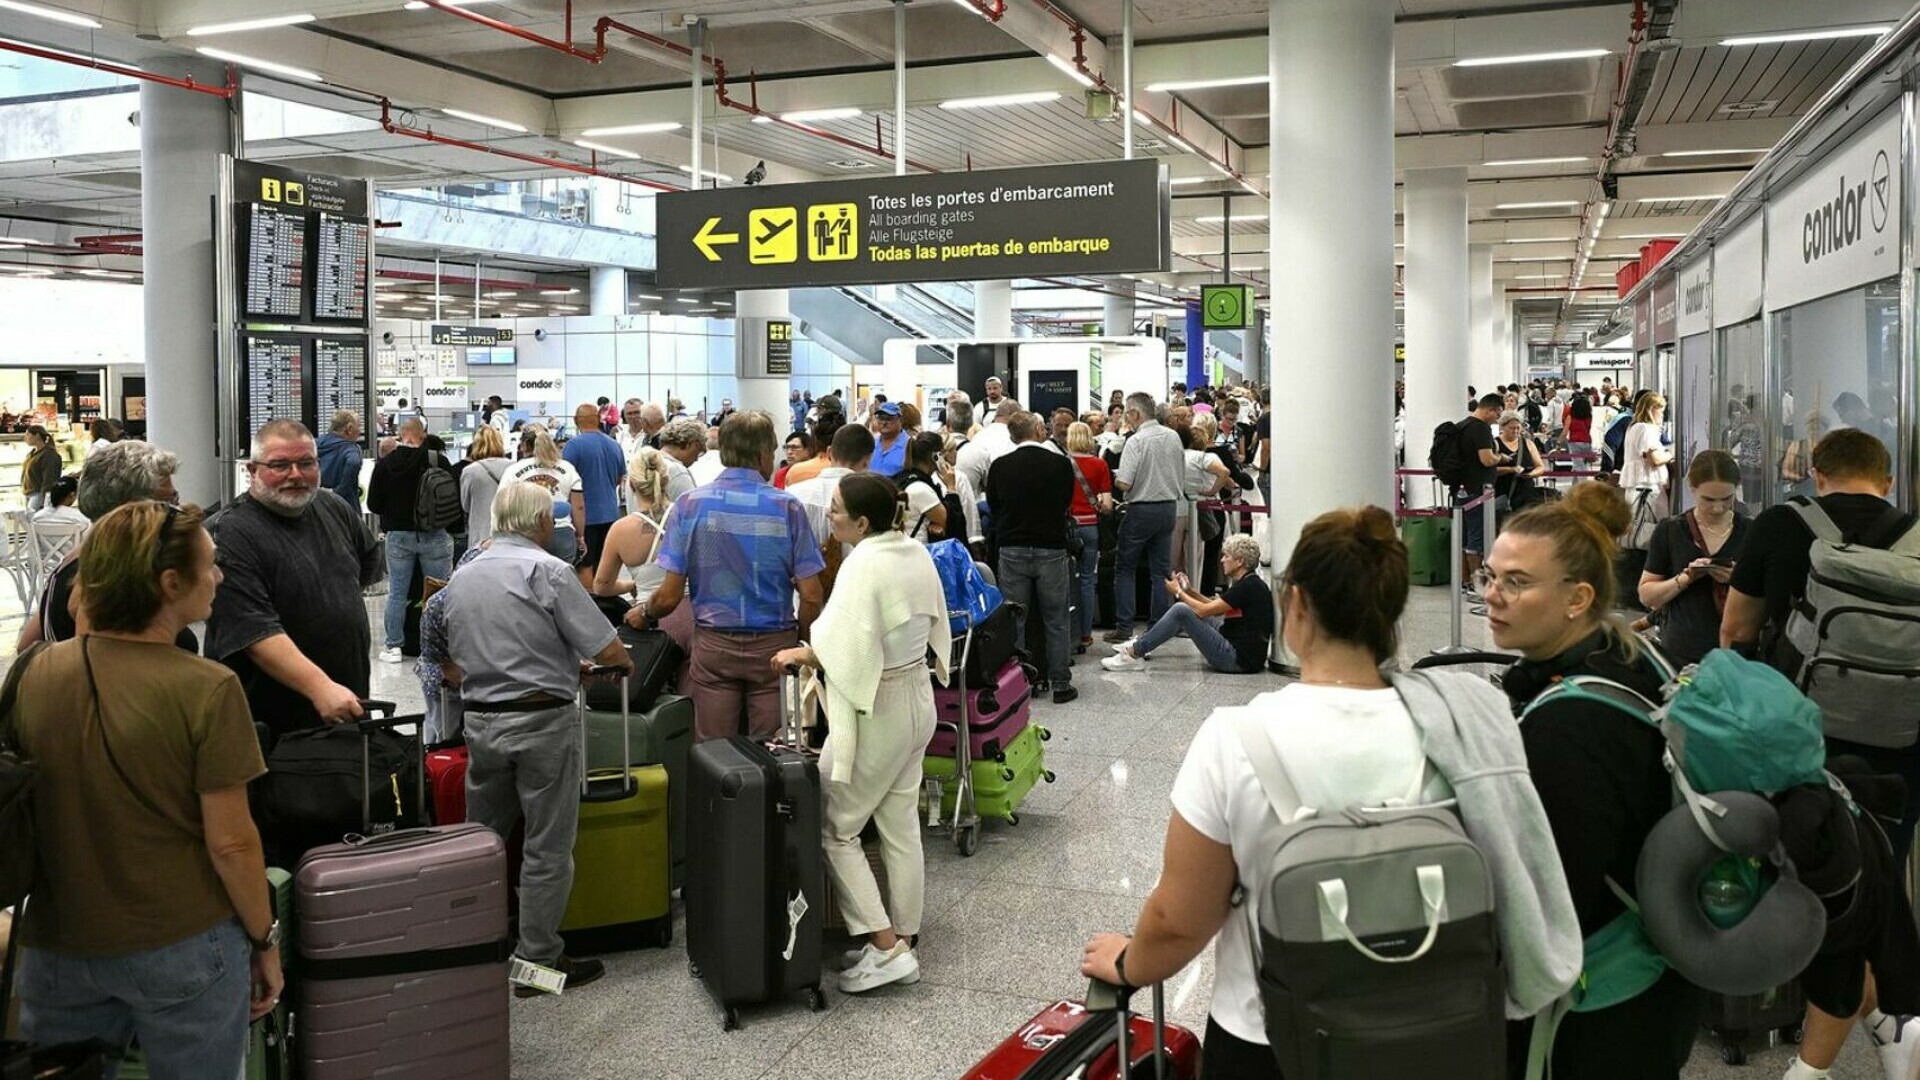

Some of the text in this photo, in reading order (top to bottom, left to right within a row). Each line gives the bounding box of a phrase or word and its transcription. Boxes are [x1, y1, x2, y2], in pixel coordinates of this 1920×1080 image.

[868, 182, 1114, 210] Totes les portes d'embarcament
[868, 210, 975, 227] All boarding gates
[1803, 175, 1866, 264] condor
[868, 227, 954, 244] Alle Flugsteige
[868, 237, 1110, 262] Todas las puertas de embarque
[1589, 357, 1630, 367] swissport
[376, 387, 400, 397] ondor
[426, 387, 456, 396] condor
[520, 379, 553, 389] condor
